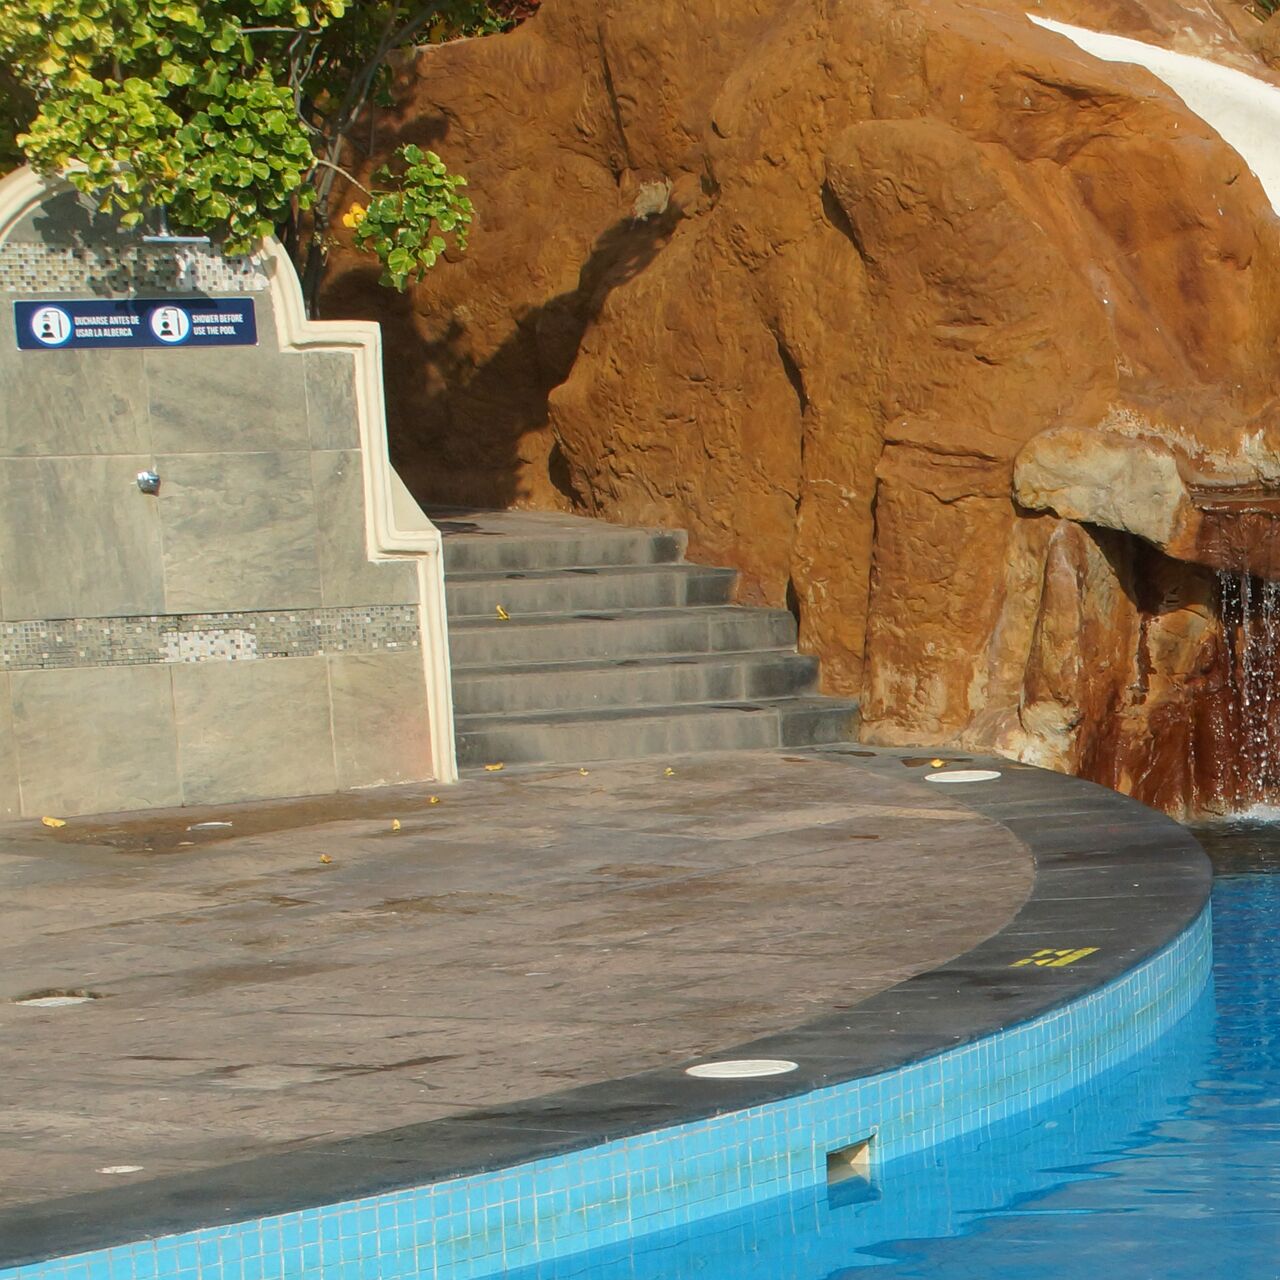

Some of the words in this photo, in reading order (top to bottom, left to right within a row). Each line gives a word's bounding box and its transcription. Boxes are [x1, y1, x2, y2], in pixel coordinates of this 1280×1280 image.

[74, 316, 109, 325] DUCHARSE
[109, 316, 130, 325] ANTES
[130, 315, 140, 325] DE
[192, 314, 219, 323] SHOWER
[219, 313, 244, 323] BEFORE
[75, 328, 93, 337] USAR
[94, 328, 103, 337] LA
[103, 327, 133, 337] ALBERCA
[193, 326, 206, 335] USE
[207, 326, 219, 335] THE
[219, 326, 236, 334] POOL
